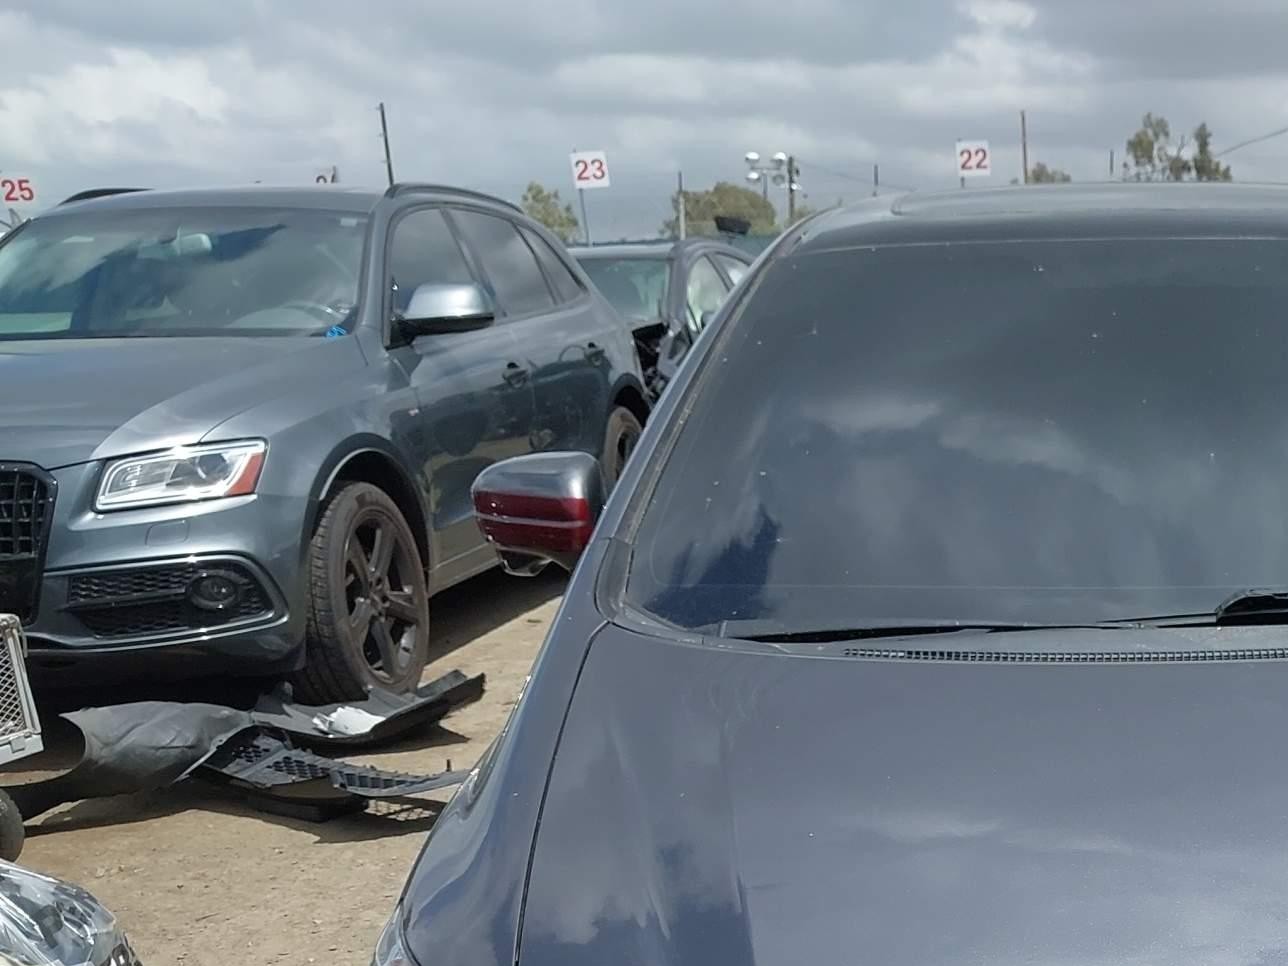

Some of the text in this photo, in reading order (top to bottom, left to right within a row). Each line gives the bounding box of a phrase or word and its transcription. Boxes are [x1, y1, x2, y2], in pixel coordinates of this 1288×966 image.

[575, 159, 605, 180] 23
[960, 149, 988, 170] 22
[1, 179, 34, 201] 25
